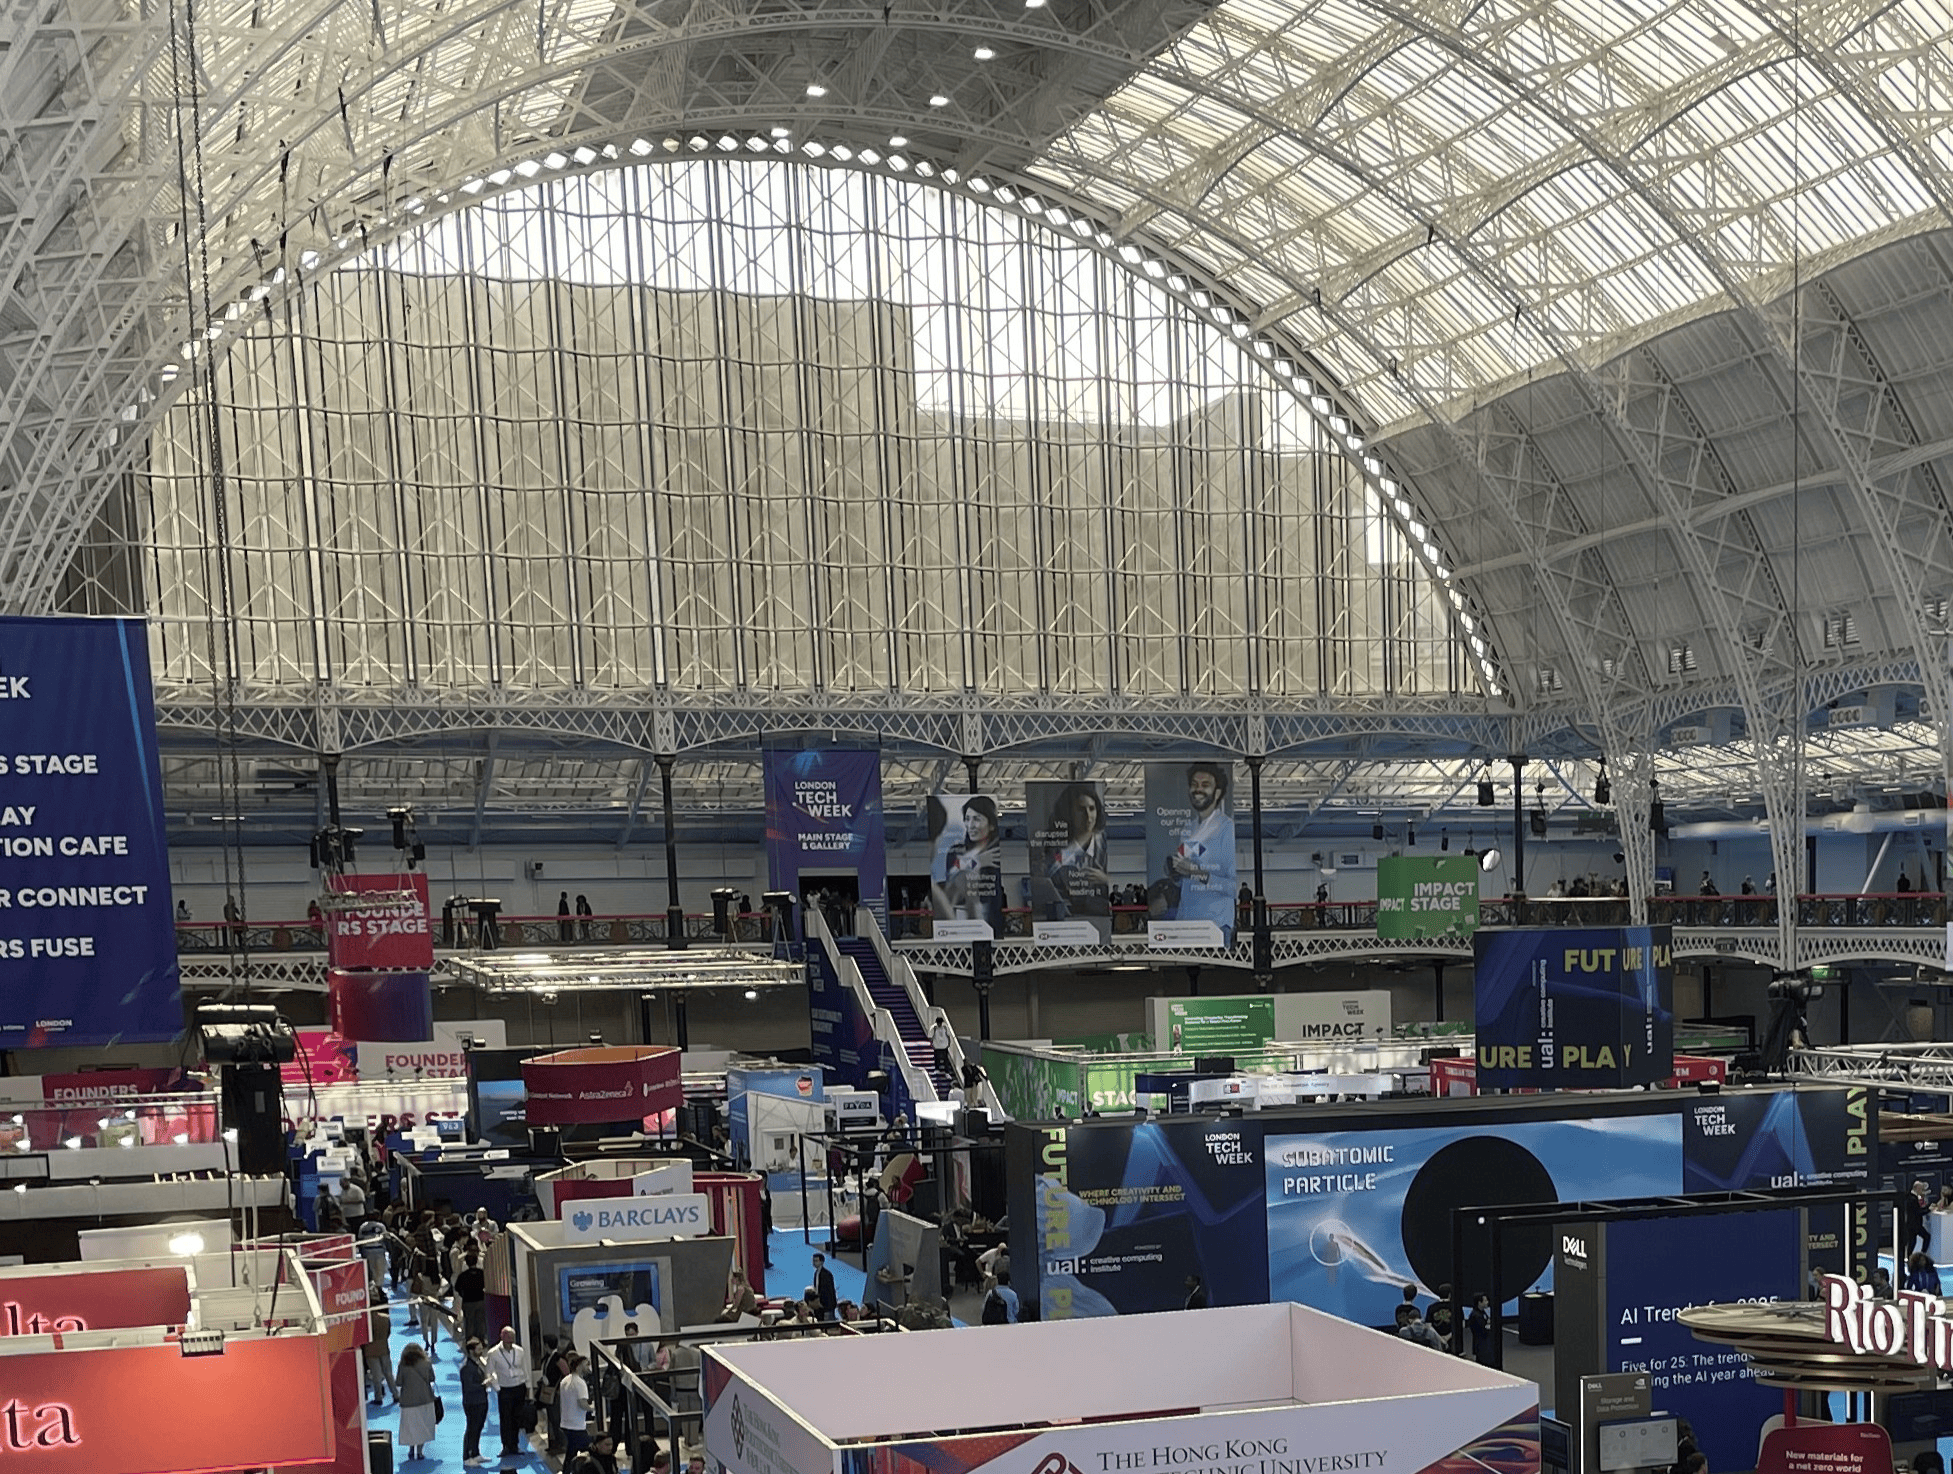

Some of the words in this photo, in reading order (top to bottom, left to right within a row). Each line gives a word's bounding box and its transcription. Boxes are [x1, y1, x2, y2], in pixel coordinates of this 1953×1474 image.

[14, 754, 98, 775] STAGE
[794, 781, 836, 790] LONDON
[796, 791, 837, 804] TECH
[808, 804, 853, 817] WEEK
[0, 837, 54, 857] ION
[59, 835, 129, 857] CAFE
[797, 833, 823, 842] MAIN
[824, 833, 854, 842] STAGE
[809, 842, 851, 850] GALLERY
[17, 886, 148, 907] CONNECT
[1413, 882, 1475, 897] IMPACT
[1410, 897, 1461, 912] STAGE
[337, 921, 362, 936] RS
[366, 919, 428, 935] STAGE
[30, 937, 95, 958] FUSE
[1564, 949, 1617, 973] FUT
[1622, 947, 1643, 972] URE
[1302, 1022, 1365, 1038] IMPACT
[1479, 1045, 1533, 1069] URE
[1562, 1045, 1617, 1069] PLA
[1623, 1043, 1632, 1068] Y
[53, 1084, 139, 1101] FOUNDERS
[1693, 1106, 1725, 1114] LONDON
[1694, 1114, 1726, 1126] TECH
[1204, 1132, 1241, 1141] LONDON
[1702, 1123, 1737, 1137] WEEK
[1205, 1141, 1241, 1154] TECH
[1215, 1151, 1253, 1165] WEEK
[1282, 1145, 1395, 1168] SUBATOMIC
[1283, 1172, 1377, 1195] PARTICLE
[1771, 1170, 1804, 1189] ual:
[1078, 1189, 1110, 1199] WHERE
[1110, 1186, 1161, 1197] CREATIVITY
[1162, 1185, 1183, 1194] AND
[1140, 1193, 1186, 1204] INTERSECT
[598, 1206, 700, 1228] BARCLAYS
[1562, 1236, 1588, 1258] DELL
[1047, 1255, 1087, 1275] ual:
[1620, 1307, 1638, 1325] AI
[1621, 1360, 1647, 1373] Five
[1649, 1358, 1667, 1371] for
[1692, 1353, 1714, 1367] The
[1672, 1371, 1692, 1386] the
[1695, 1369, 1708, 1383] AI
[1710, 1369, 1737, 1386] year
[1096, 1451, 1147, 1471] THE
[1151, 1444, 1220, 1466] HONG
[1224, 1437, 1289, 1459] KONG
[1785, 1450, 1806, 1459] New
[1807, 1452, 1849, 1462] materials
[1850, 1453, 1864, 1463] for
[1796, 1463, 1812, 1471] net
[1813, 1464, 1834, 1472] zero
[1836, 1465, 1863, 1473] world
